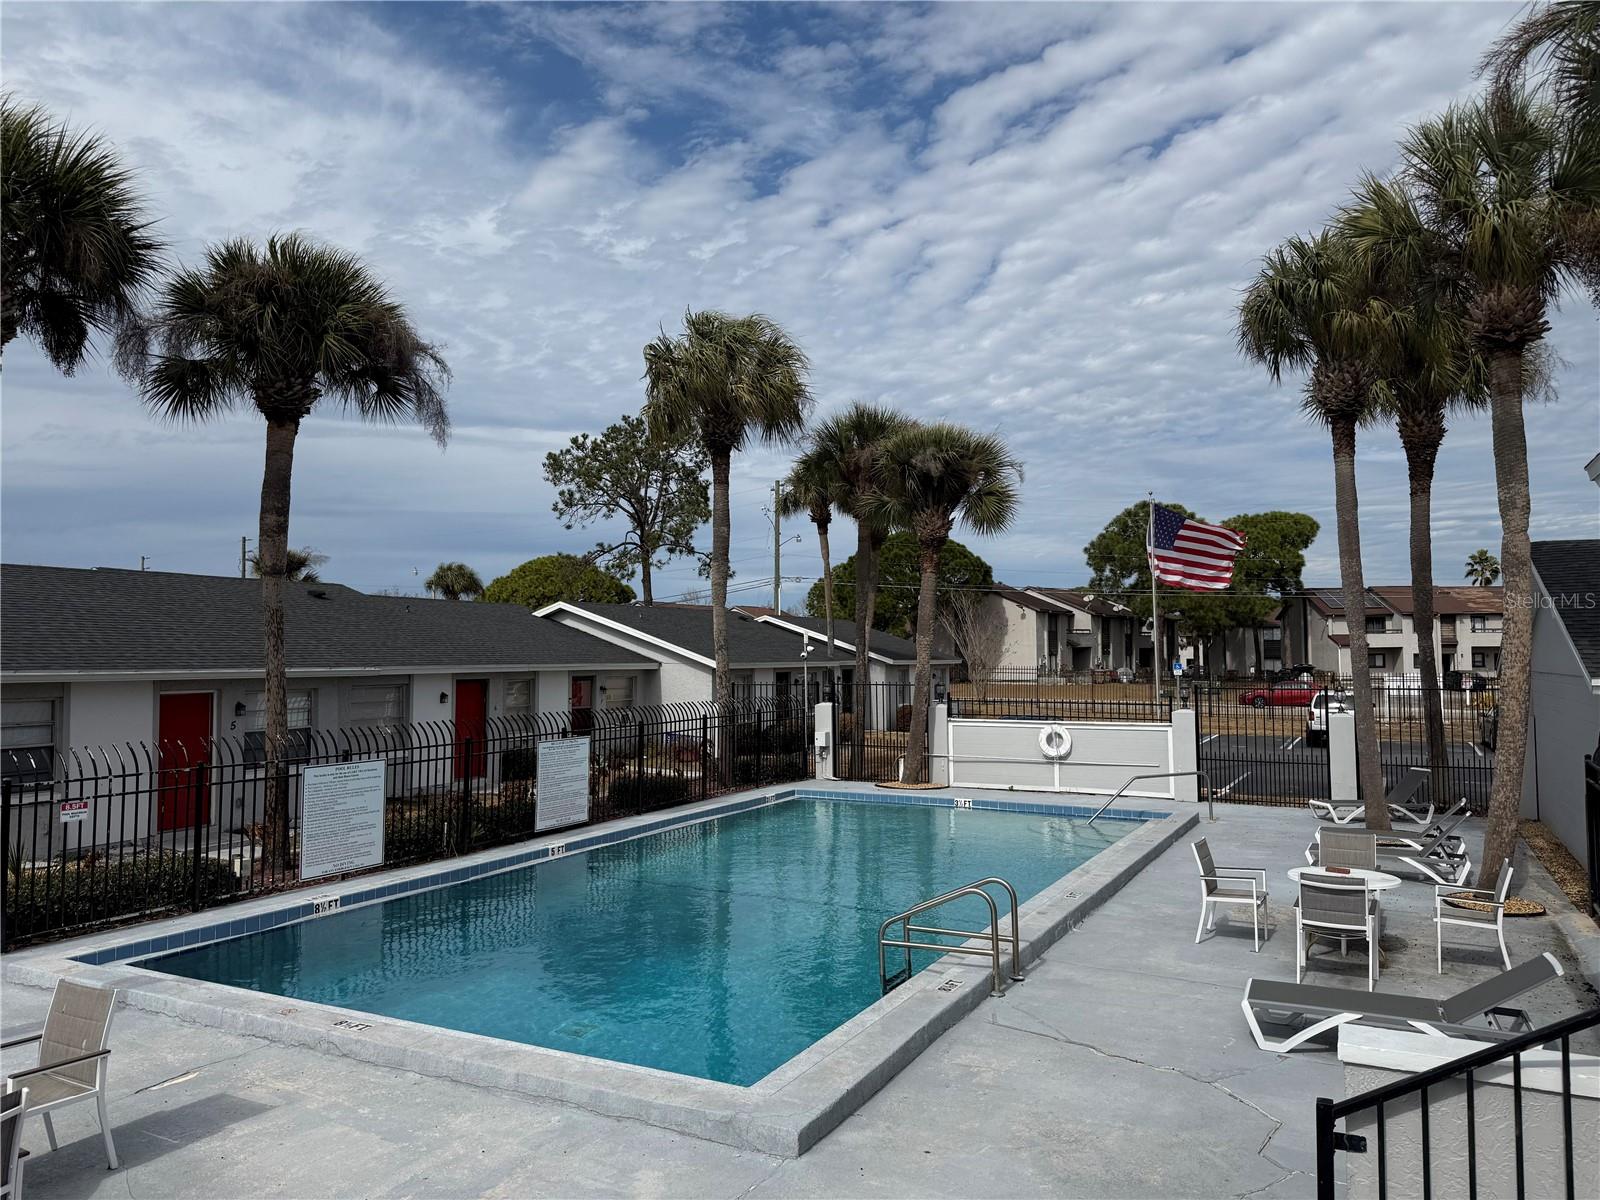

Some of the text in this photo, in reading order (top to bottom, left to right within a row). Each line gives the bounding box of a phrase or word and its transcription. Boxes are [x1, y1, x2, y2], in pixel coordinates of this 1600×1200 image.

[230, 720, 236, 730] 5
[557, 845, 564, 855] FT
[328, 898, 339, 910] FT
